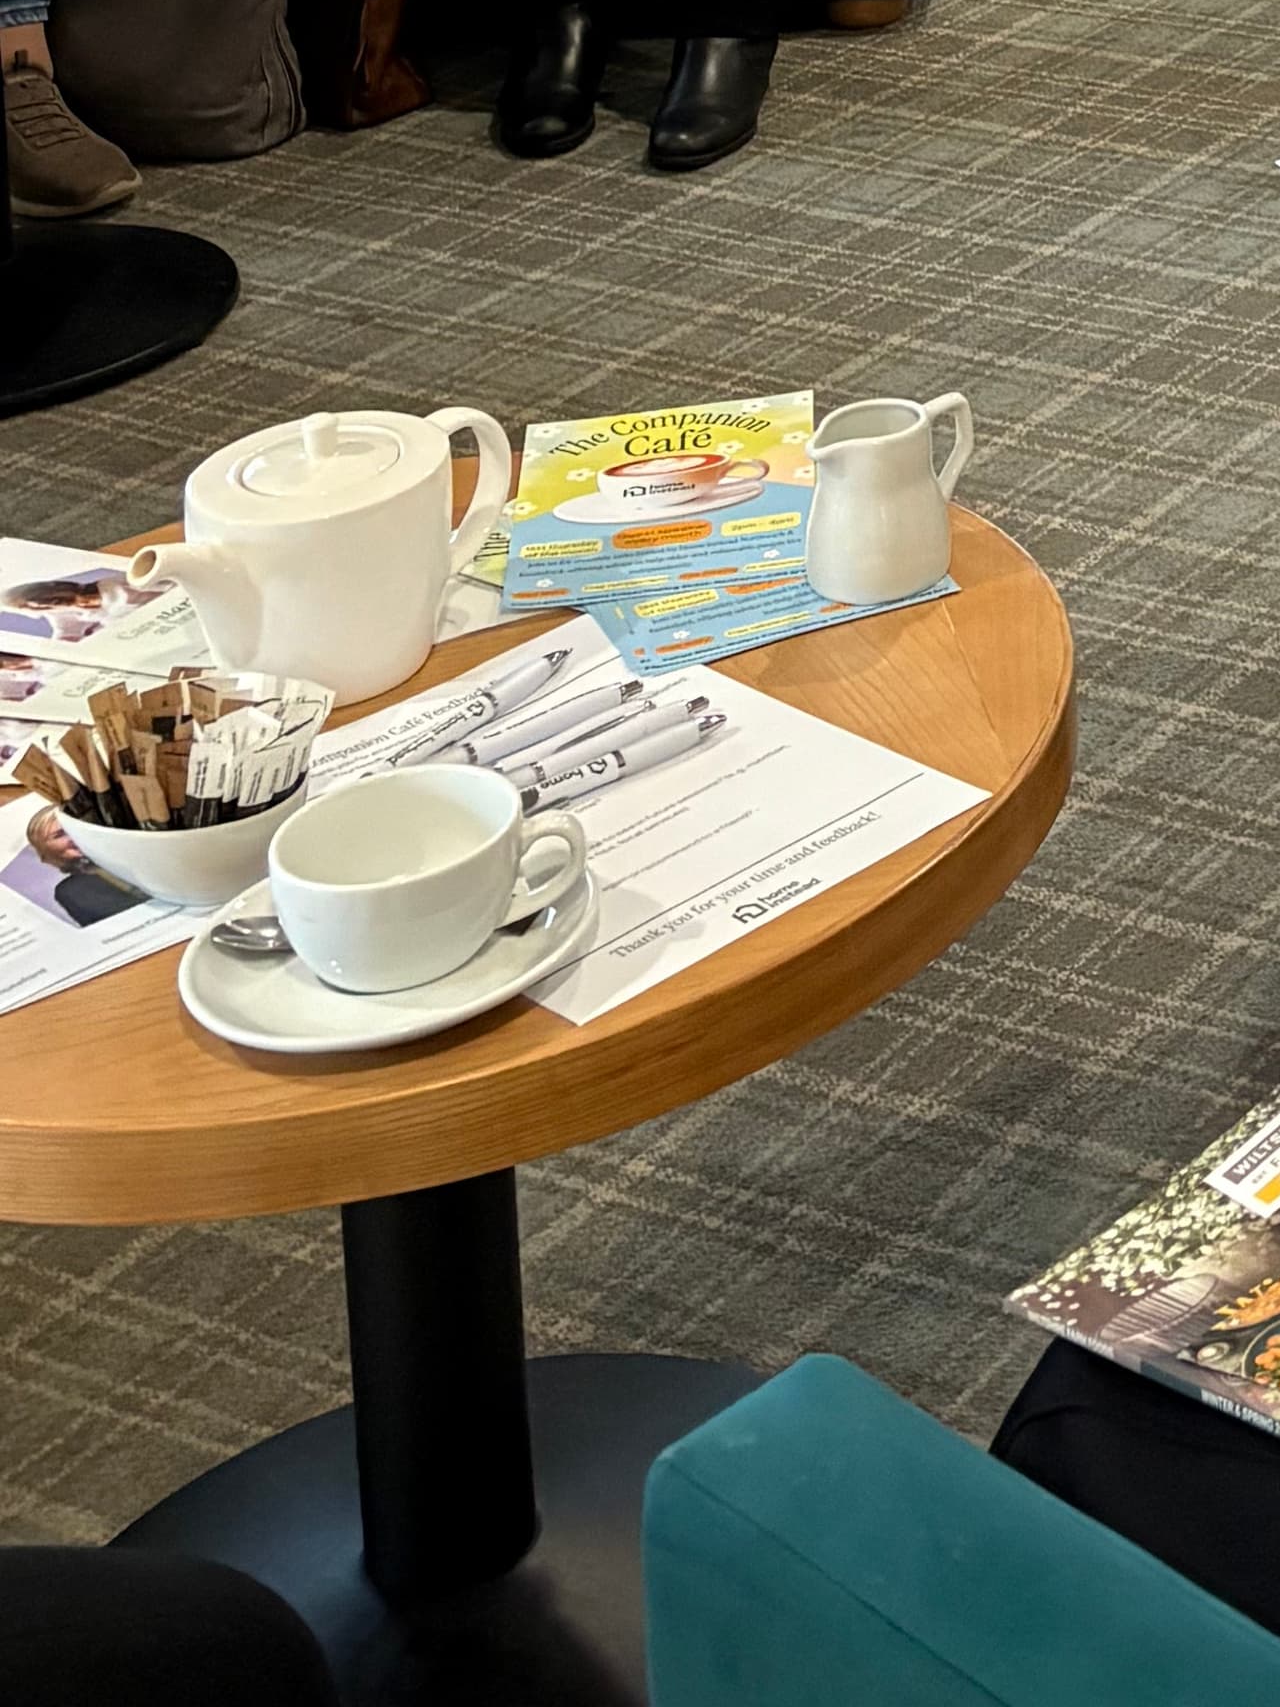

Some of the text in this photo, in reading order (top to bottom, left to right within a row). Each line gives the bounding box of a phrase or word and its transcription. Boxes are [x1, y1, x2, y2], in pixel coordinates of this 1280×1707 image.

[548, 411, 771, 457] The Companion
[624, 426, 713, 457] Café
[312, 733, 390, 768] ompanion
[388, 717, 423, 737] Café
[540, 769, 584, 789] home
[609, 810, 881, 958] Thank you for your time and feedback!
[759, 880, 800, 904] home
[769, 877, 823, 908] instead
